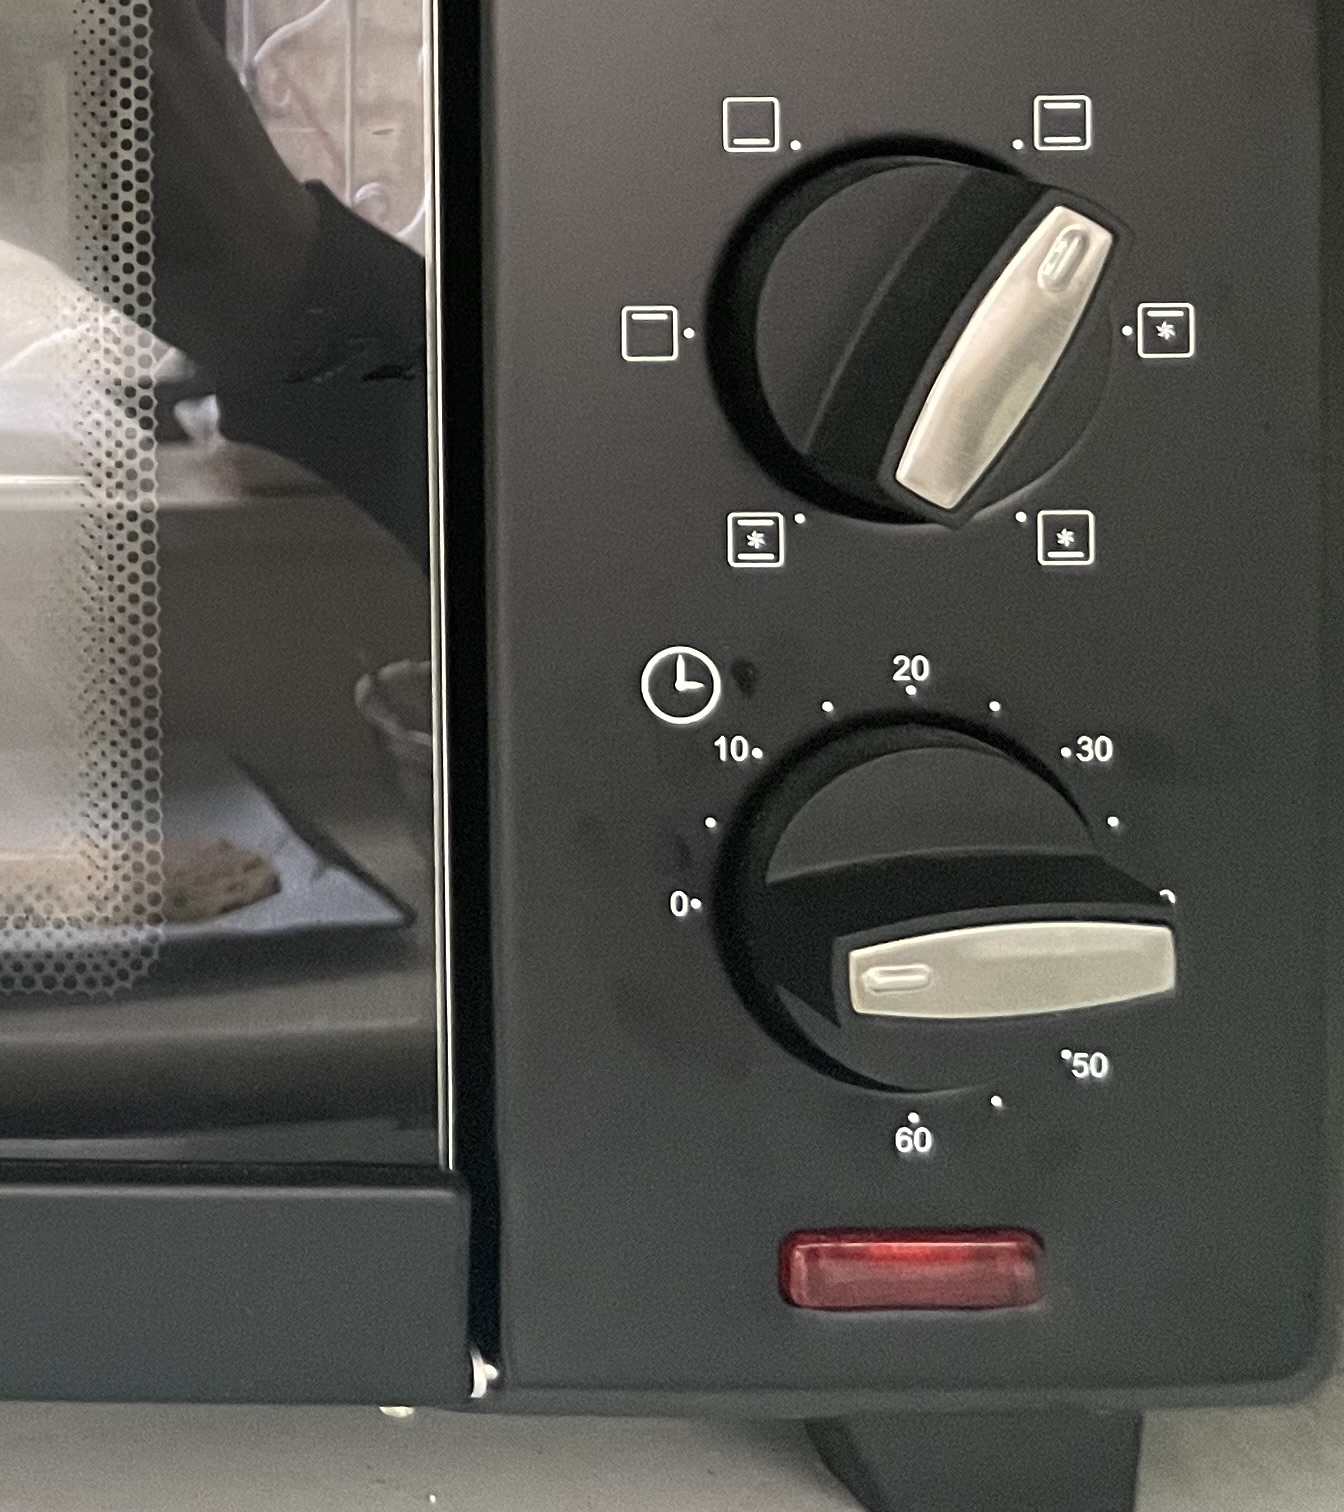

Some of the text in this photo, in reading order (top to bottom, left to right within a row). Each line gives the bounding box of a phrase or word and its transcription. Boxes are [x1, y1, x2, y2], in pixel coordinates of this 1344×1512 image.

[892, 654, 931, 682] 20
[714, 735, 750, 762] 10
[1075, 735, 1114, 763] 30
[670, 890, 689, 918] 0
[1071, 1051, 1110, 1079] 50
[895, 1126, 934, 1154] 60
